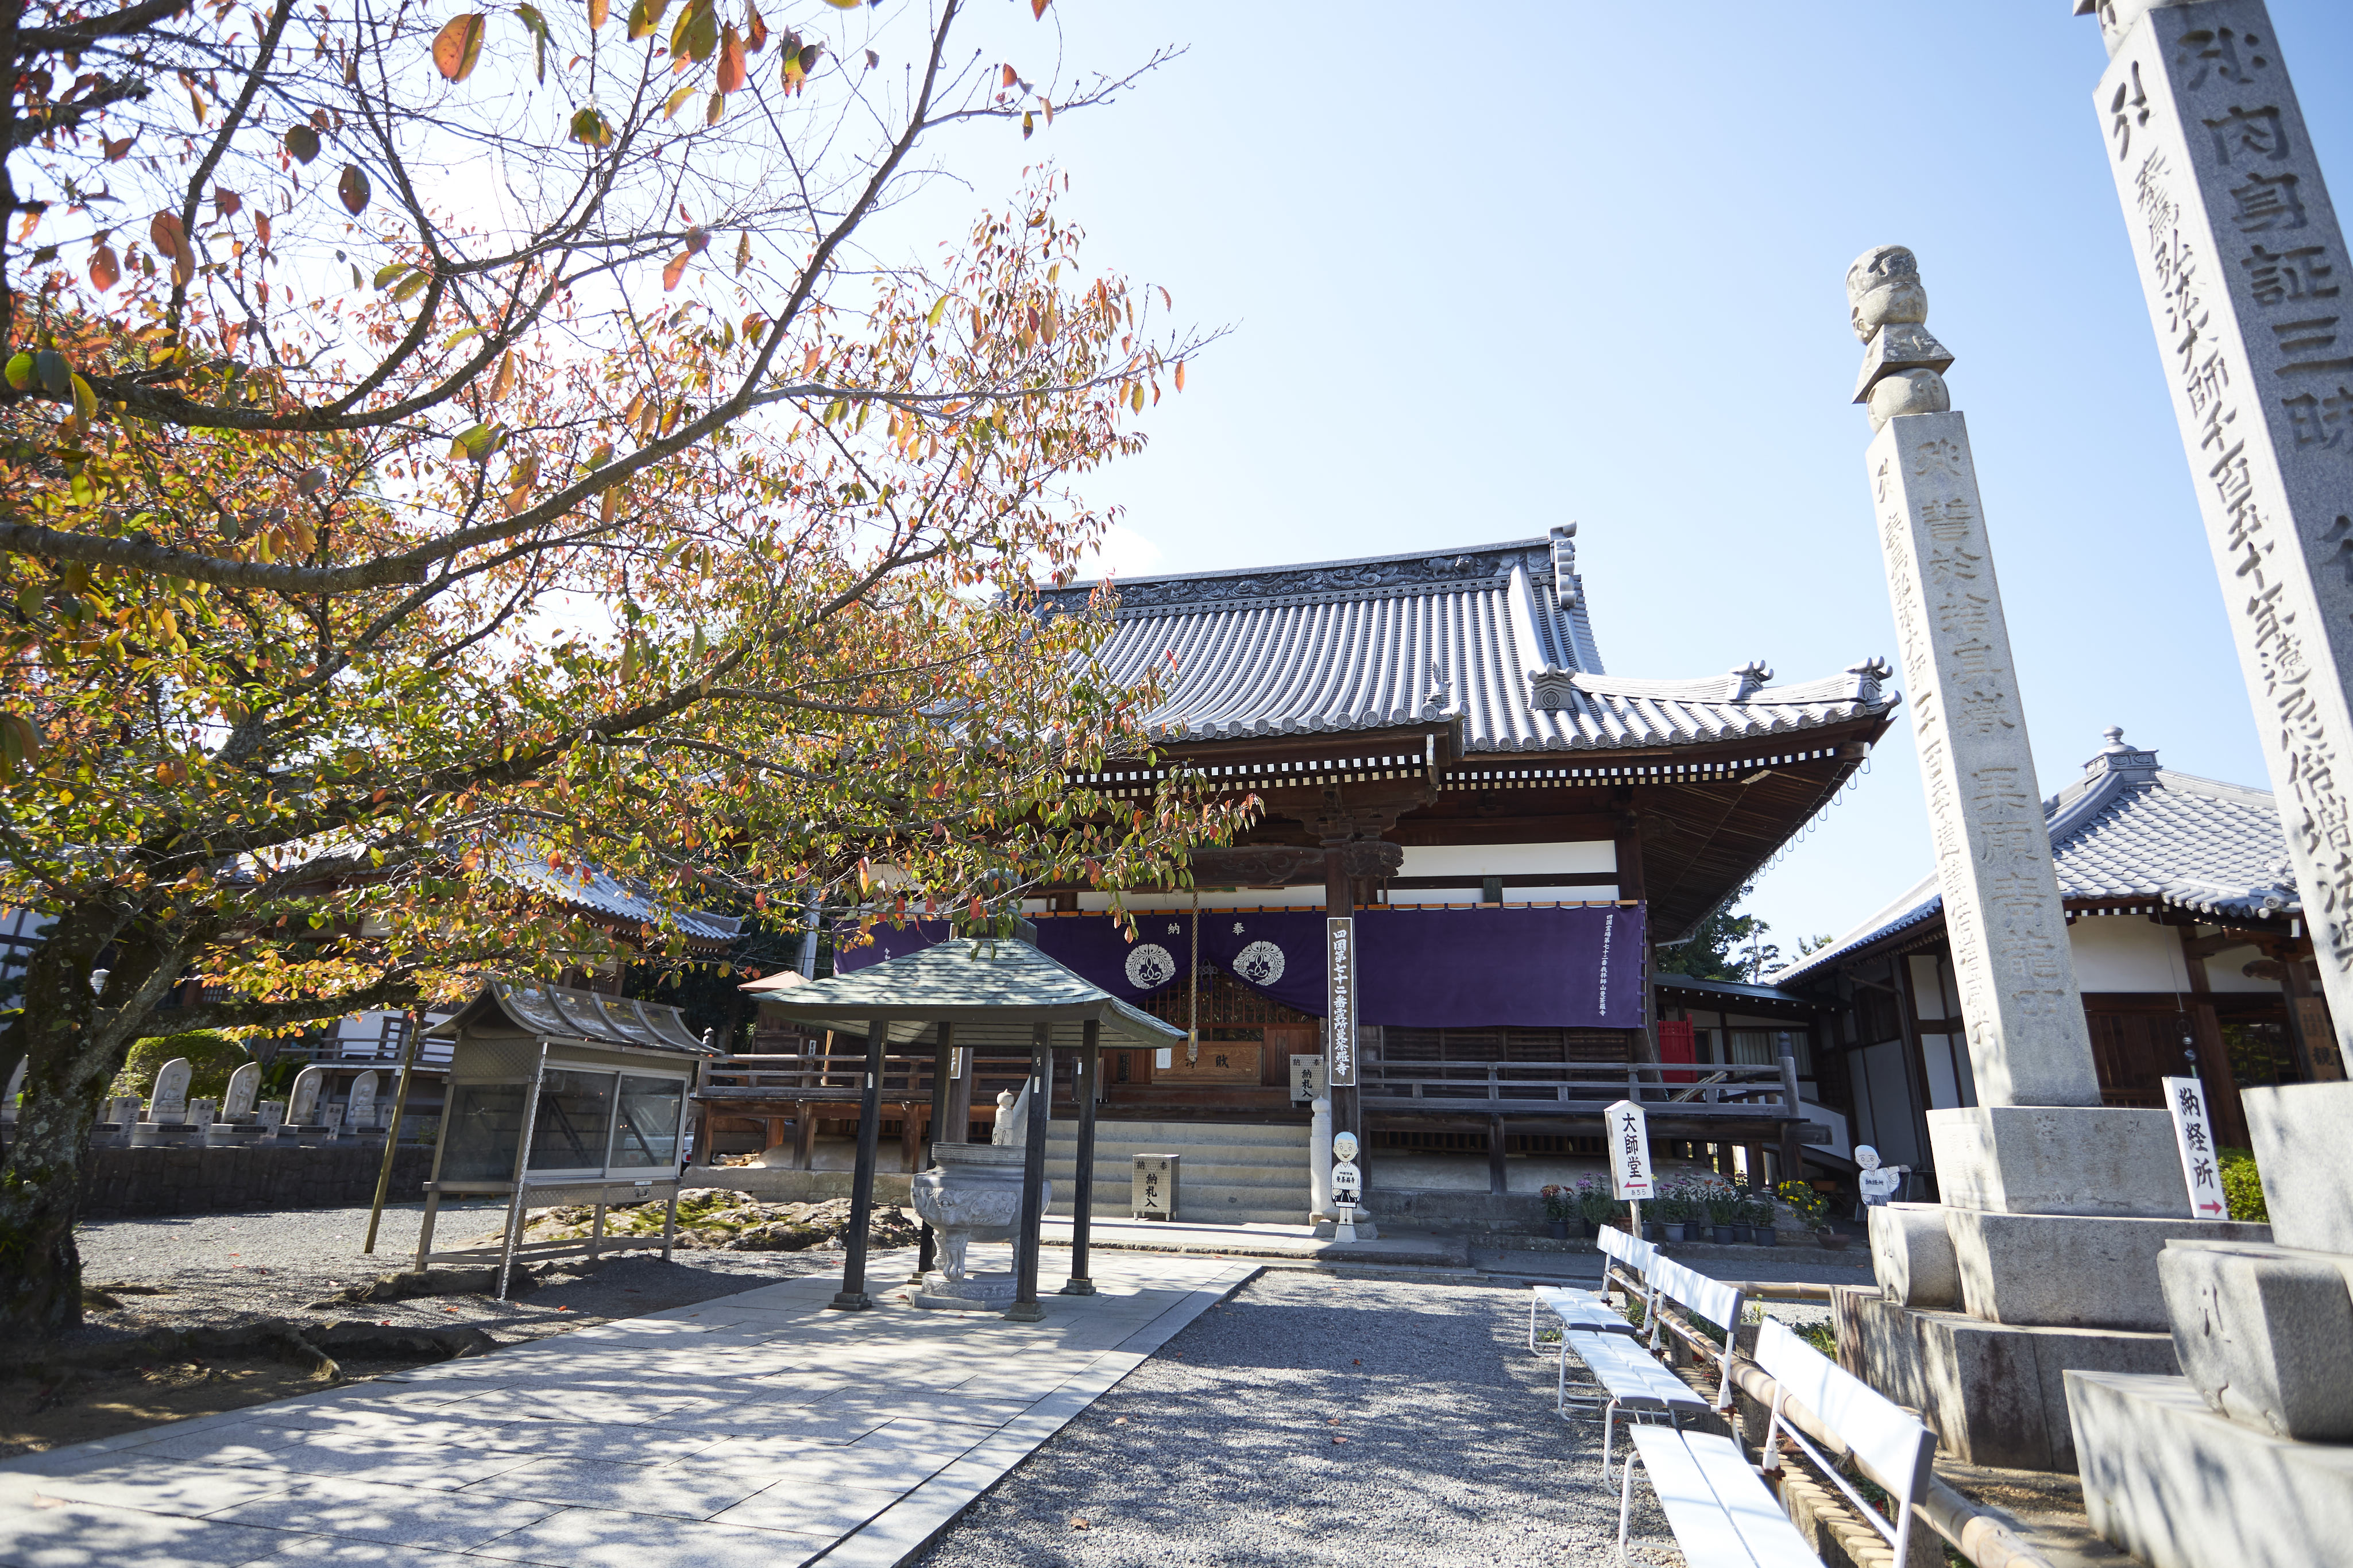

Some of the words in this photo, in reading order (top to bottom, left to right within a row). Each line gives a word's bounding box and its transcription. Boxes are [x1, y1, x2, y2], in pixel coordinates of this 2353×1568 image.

[1168, 923, 1180, 935] 納
[1232, 922, 1245, 936] 奉
[884, 948, 890, 961] 令和
[1301, 1069, 1313, 1098] 納札入
[1622, 1113, 1642, 1178] 大師堂
[2179, 1087, 2214, 1189] 納経所
[1145, 1173, 1158, 1207] 納札入
